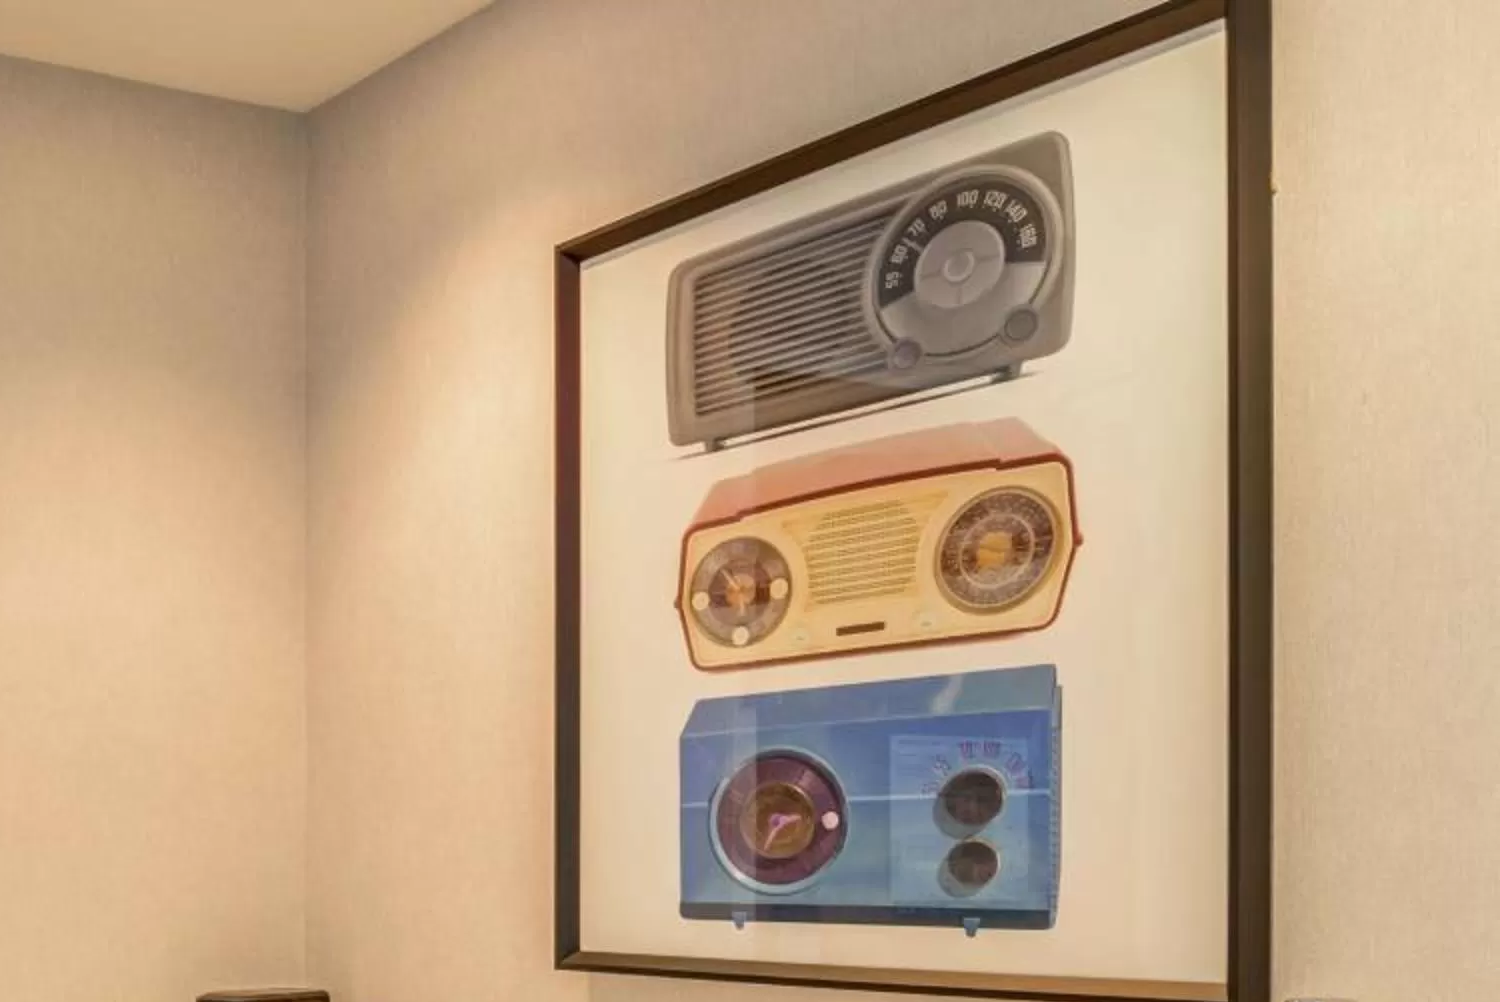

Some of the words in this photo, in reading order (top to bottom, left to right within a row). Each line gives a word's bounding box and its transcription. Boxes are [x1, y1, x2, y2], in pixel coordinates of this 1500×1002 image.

[905, 217, 926, 237] 70
[956, 189, 980, 207] 100
[983, 189, 1008, 209] 120
[1005, 199, 1028, 223] 140
